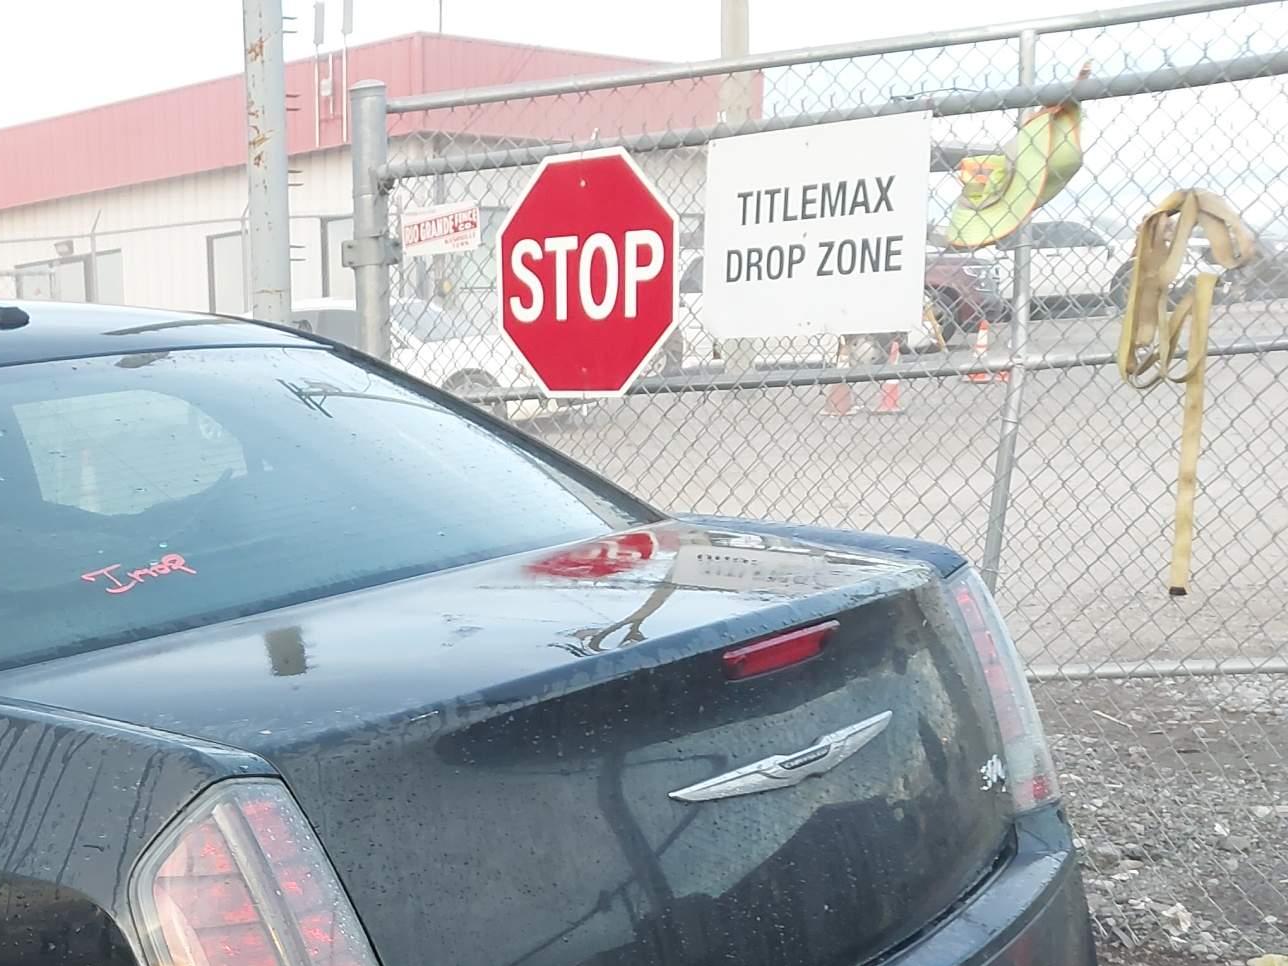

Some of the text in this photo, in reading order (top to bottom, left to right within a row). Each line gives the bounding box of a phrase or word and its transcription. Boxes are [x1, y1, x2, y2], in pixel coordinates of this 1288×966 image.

[737, 175, 896, 226] TITLEMAX
[420, 214, 455, 241] GRANDE
[510, 229, 665, 324] STOP
[726, 235, 903, 283] DROP ZONE
